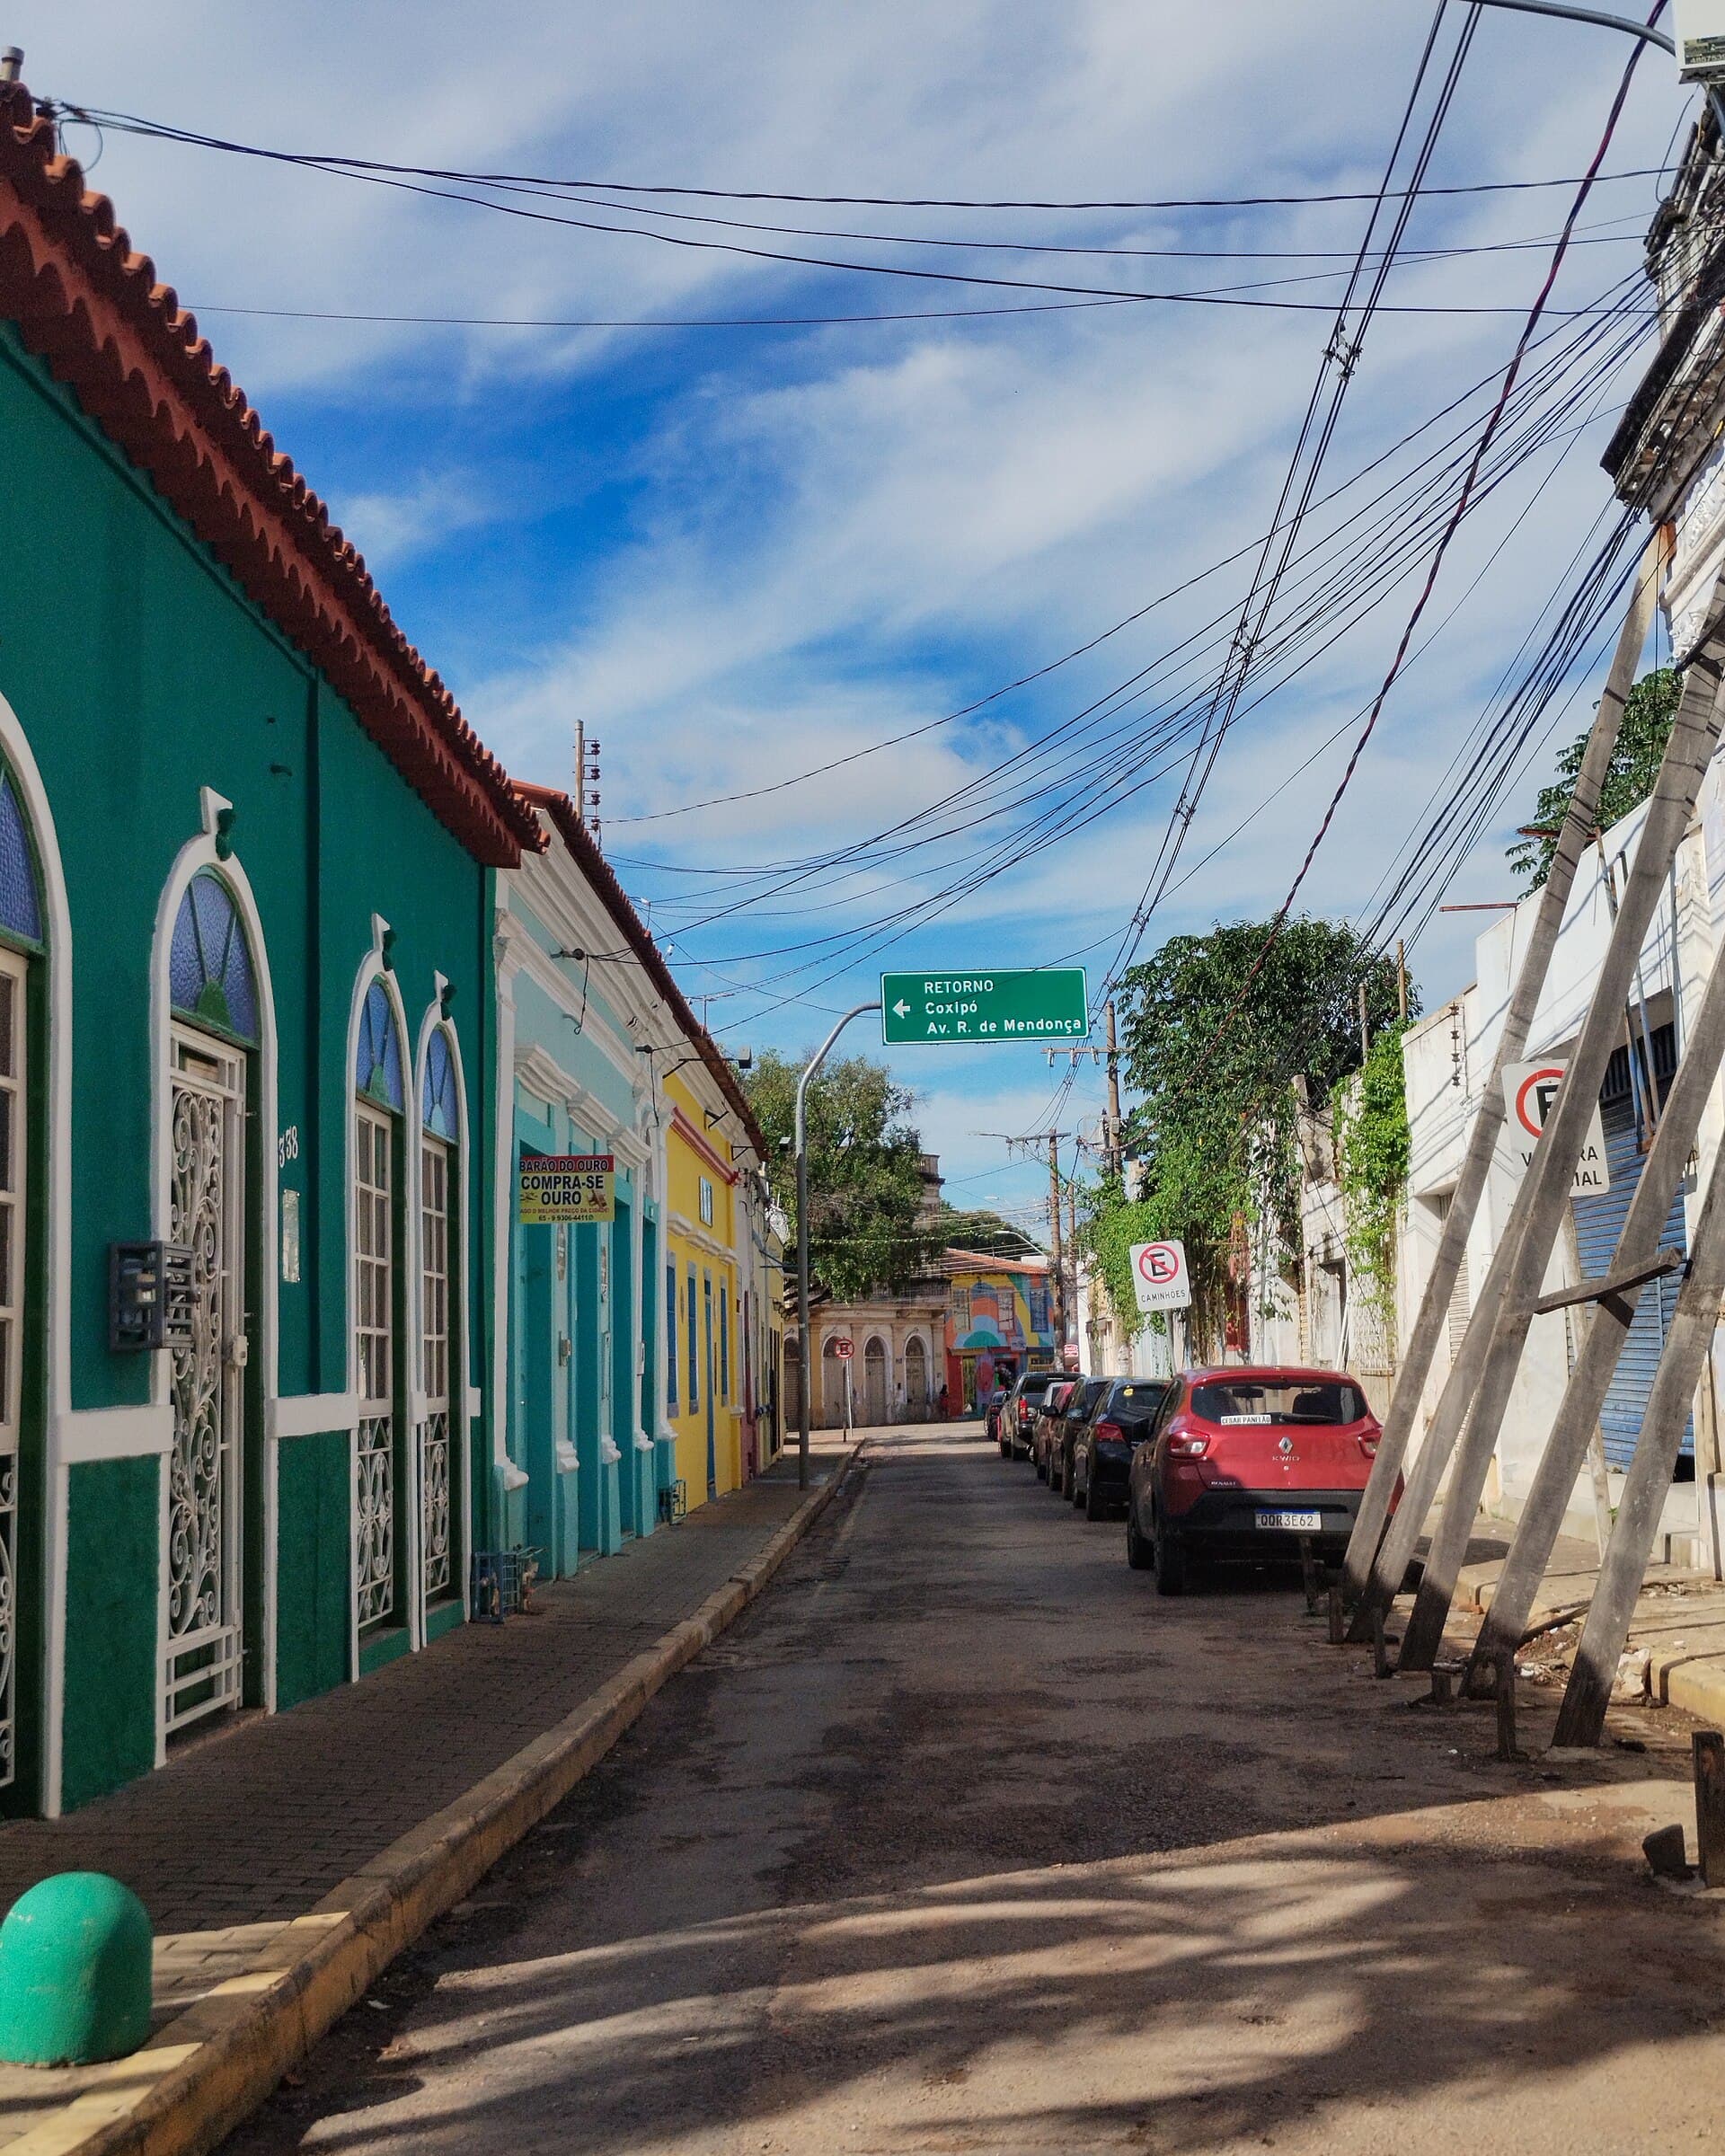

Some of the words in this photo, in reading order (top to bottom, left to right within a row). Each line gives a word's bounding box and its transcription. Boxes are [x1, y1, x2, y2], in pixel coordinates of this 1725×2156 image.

[924, 979, 994, 994] RETORNO
[925, 1000, 978, 1015] Coxipó
[926, 1021, 951, 1035] Av.
[957, 1021, 972, 1033] R.
[979, 1020, 997, 1033] de
[1004, 1019, 1082, 1034] Mendonça
[279, 1126, 298, 1168] 338
[520, 1158, 555, 1172] BARÃO
[559, 1160, 574, 1171] DO
[577, 1159, 608, 1171] OURO
[521, 1175, 604, 1189] COMPRA-SE
[541, 1191, 581, 1205] OURO
[1141, 1289, 1186, 1303] CAMINHÕES
